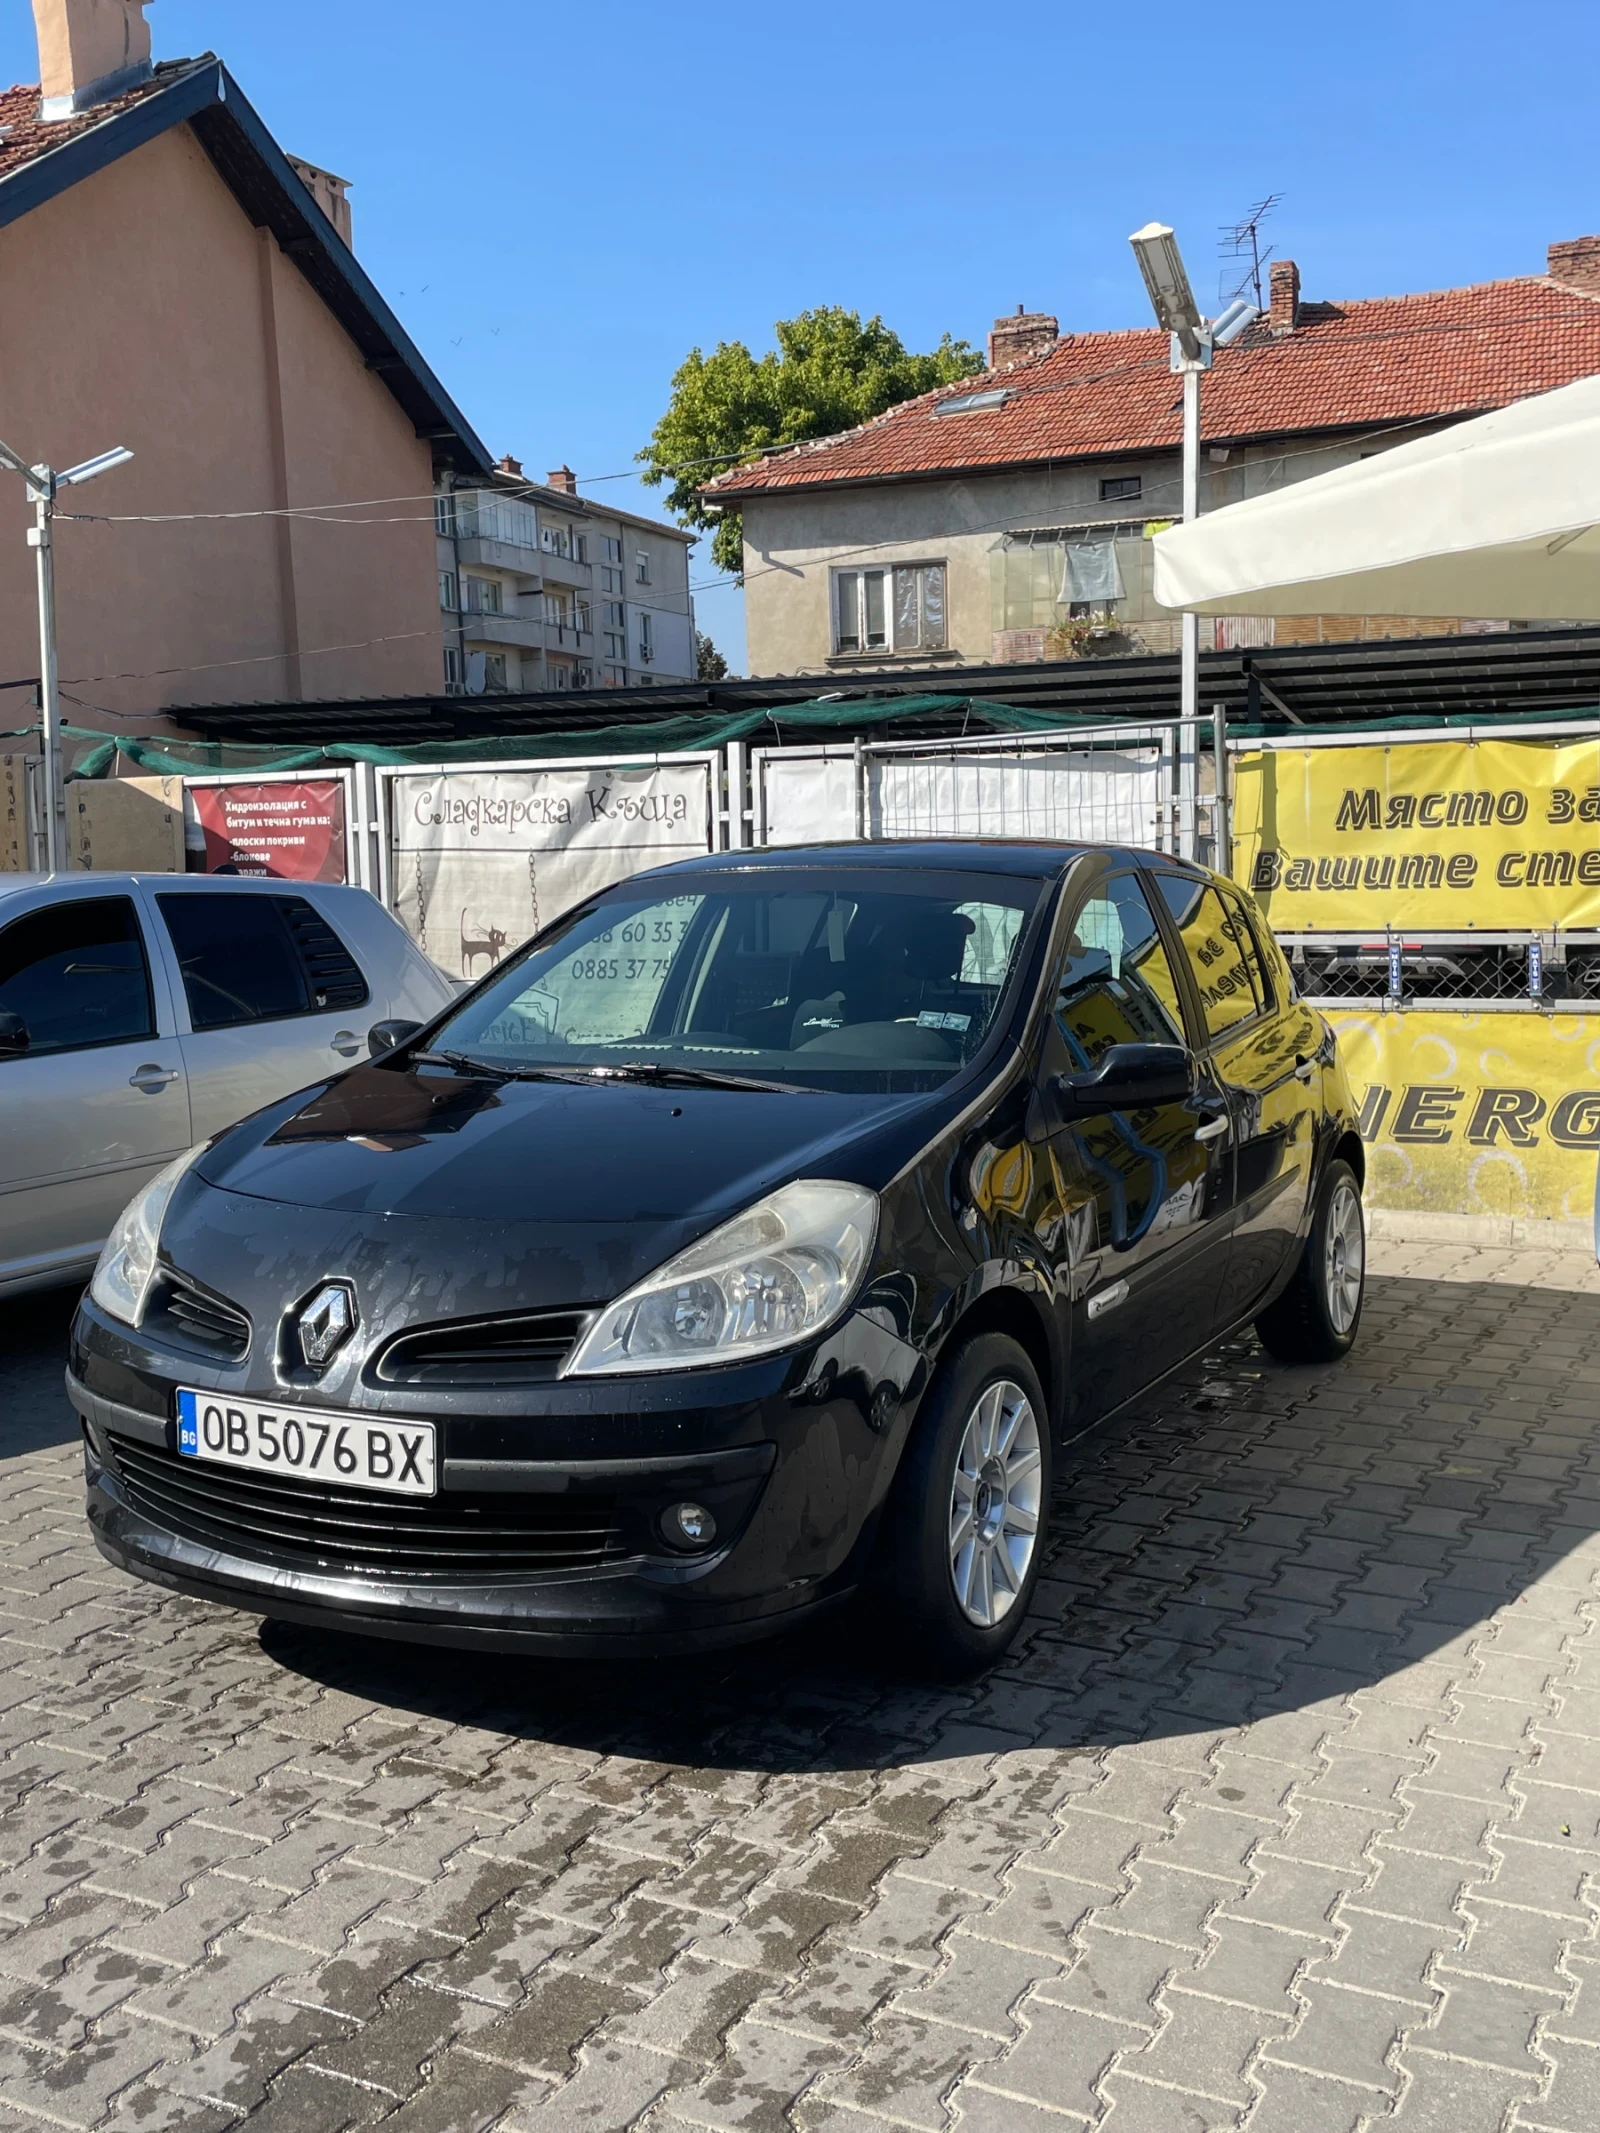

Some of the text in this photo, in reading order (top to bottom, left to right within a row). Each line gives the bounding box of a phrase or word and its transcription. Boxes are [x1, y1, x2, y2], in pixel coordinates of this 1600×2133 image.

[225, 800, 307, 813] Хидроизолация с
[414, 786, 687, 836] Сладкарска Къща
[1334, 787, 1528, 831] Място
[226, 817, 256, 829] битум
[256, 818, 263, 827] и
[263, 818, 291, 827] течна
[292, 817, 316, 828] гума
[266, 836, 305, 847] покриви
[1251, 851, 1478, 891] Вашите
[621, 922, 646, 943] 60
[651, 921, 673, 943] 35
[571, 959, 618, 980] 0885
[625, 959, 647, 979] 37
[181, 1429, 196, 1446] BG
